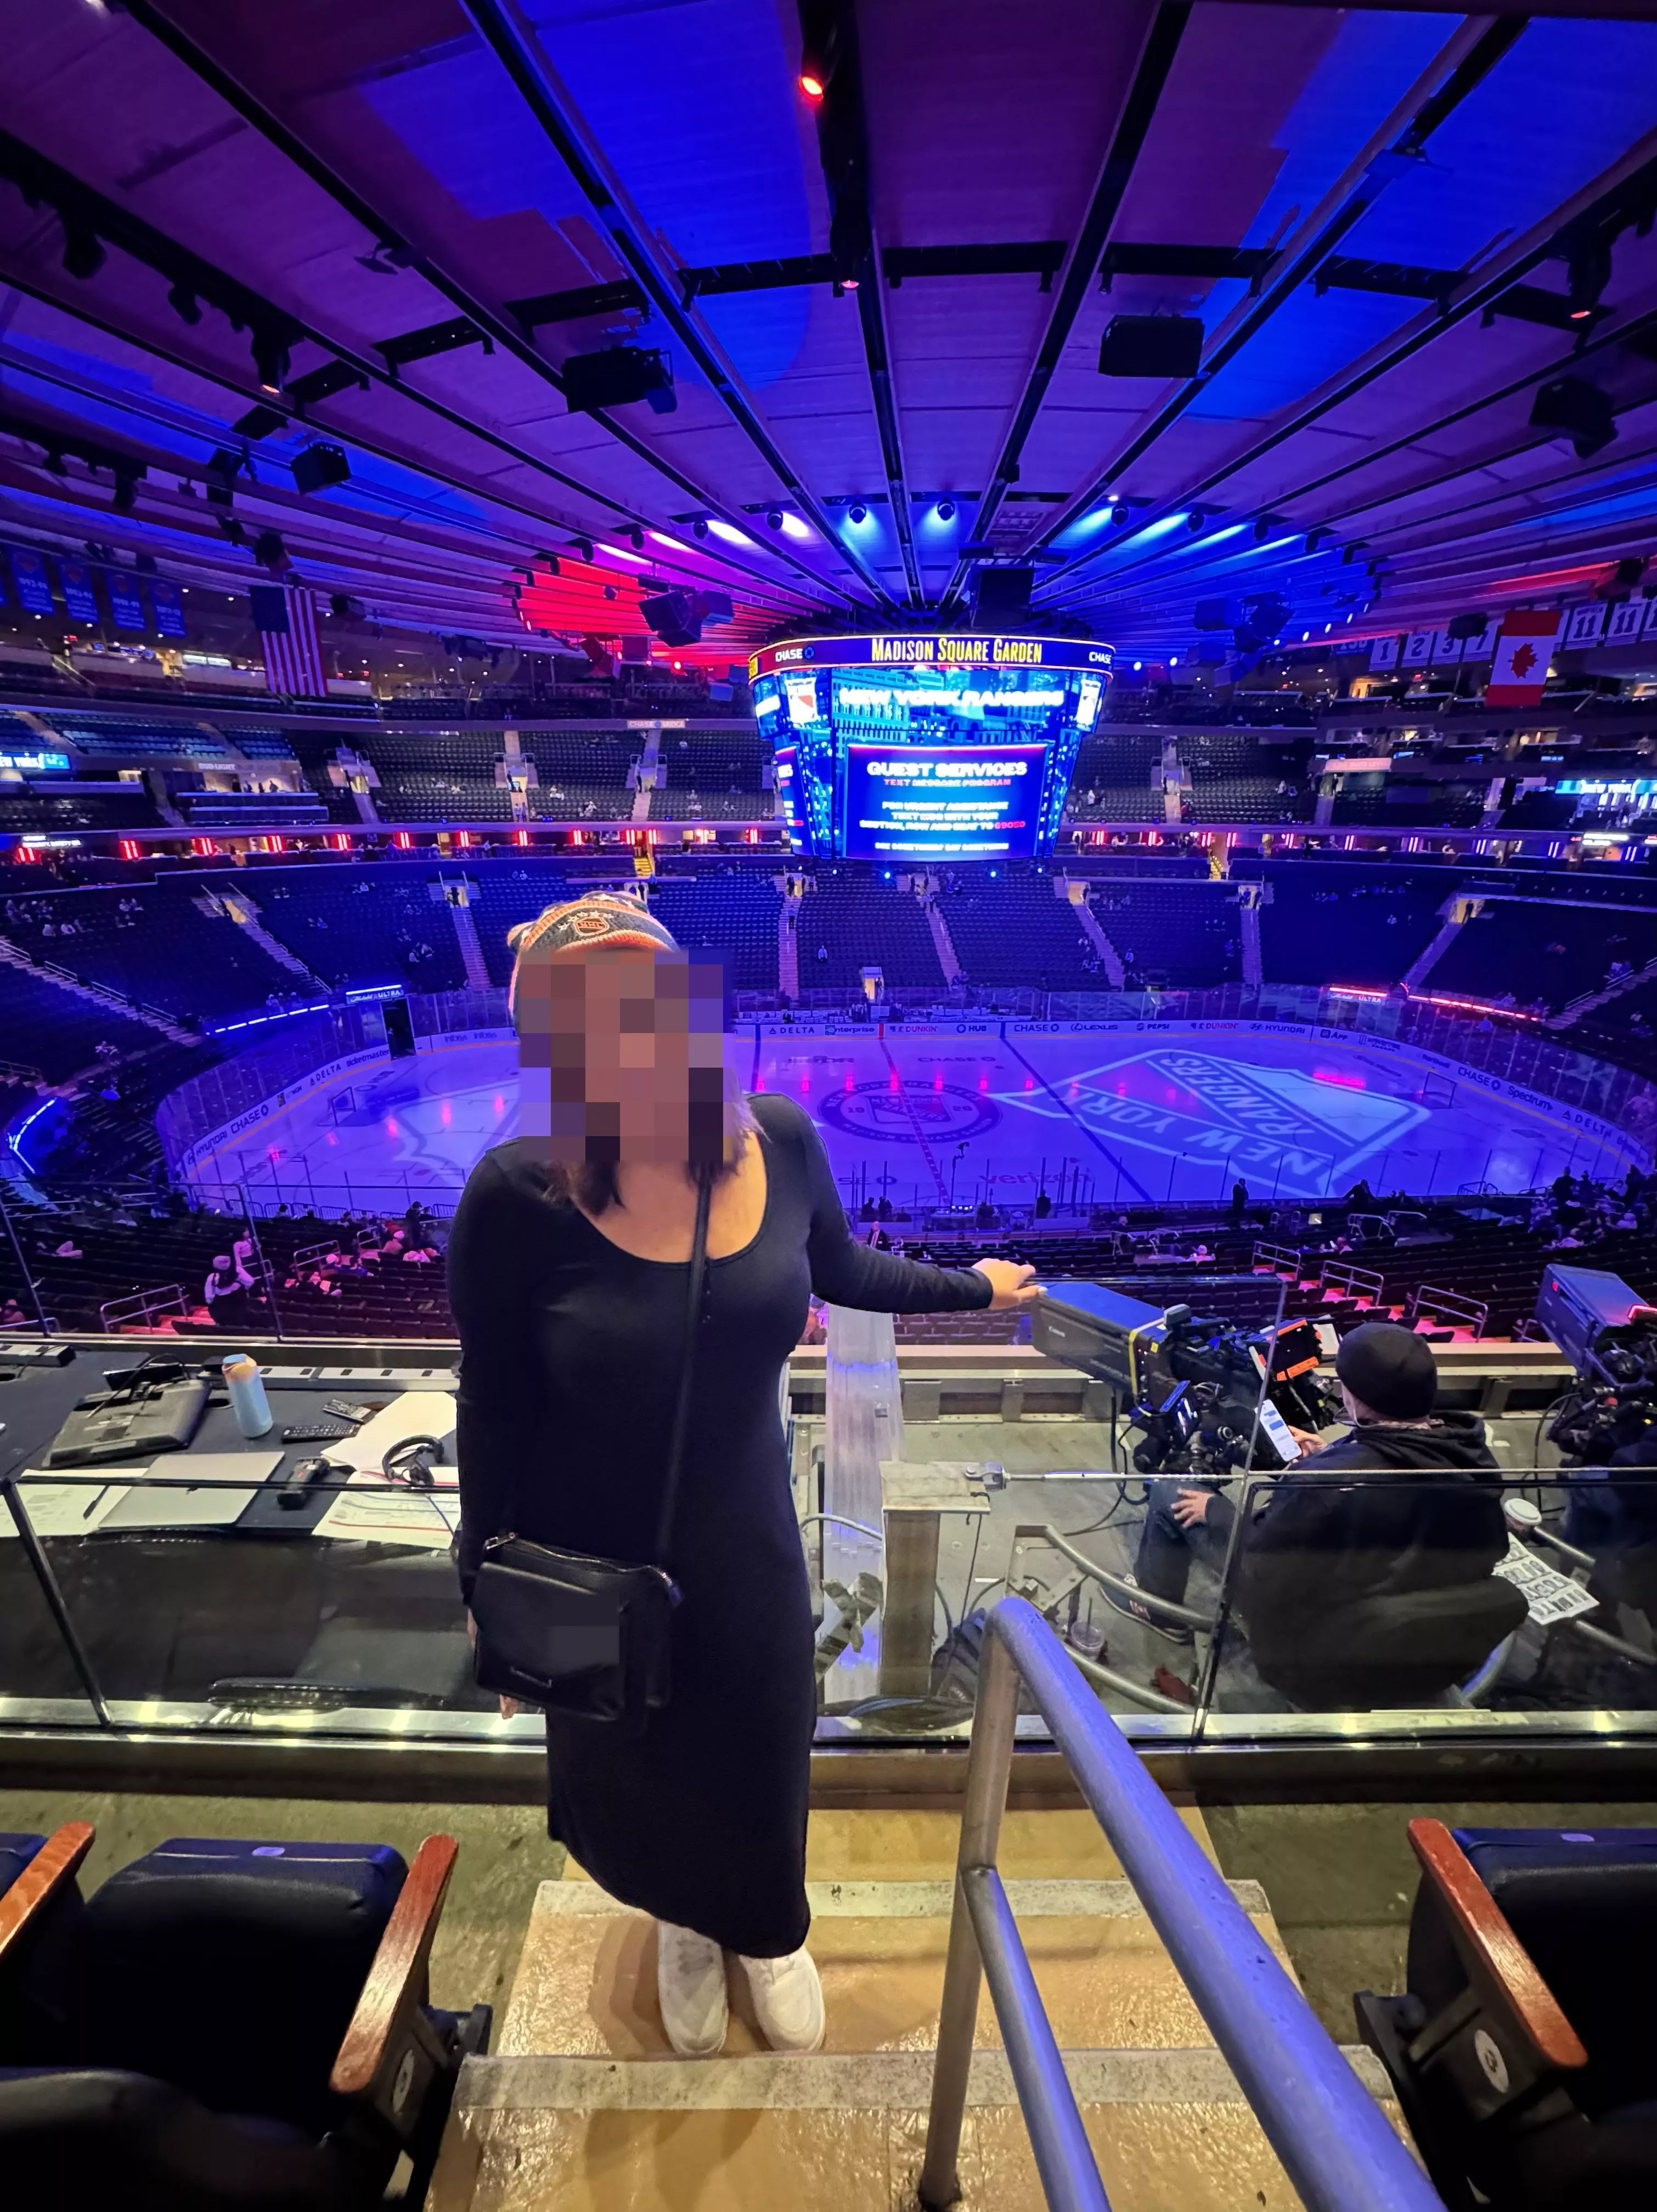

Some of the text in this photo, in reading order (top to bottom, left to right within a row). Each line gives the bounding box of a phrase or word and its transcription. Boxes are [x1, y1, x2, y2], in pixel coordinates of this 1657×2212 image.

[1573, 614, 1597, 639] 11
[1613, 608, 1637, 634] 11
[775, 647, 803, 663] CHASE
[872, 637, 1042, 664] MADISON SQUARE GARDEN
[1379, 641, 1389, 661] 1
[1411, 637, 1425, 657] 2
[1089, 651, 1112, 665] CHASE
[867, 761, 1028, 777] GUEST SERVICES
[884, 778, 911, 787] TEXT
[377, 990, 401, 998] ULTRA
[1265, 1024, 1305, 1034] HYUNDAI
[316, 1063, 341, 1082] DELTA
[1457, 1066, 1490, 1086] CHASE
[1159, 1057, 1316, 1135] RANGERS
[1507, 1085, 1549, 1110] Spectrum
[230, 1109, 261, 1135] CHASE
[196, 1131, 228, 1156] HYUNDAI
[1182, 1129, 1327, 1176] NEW
